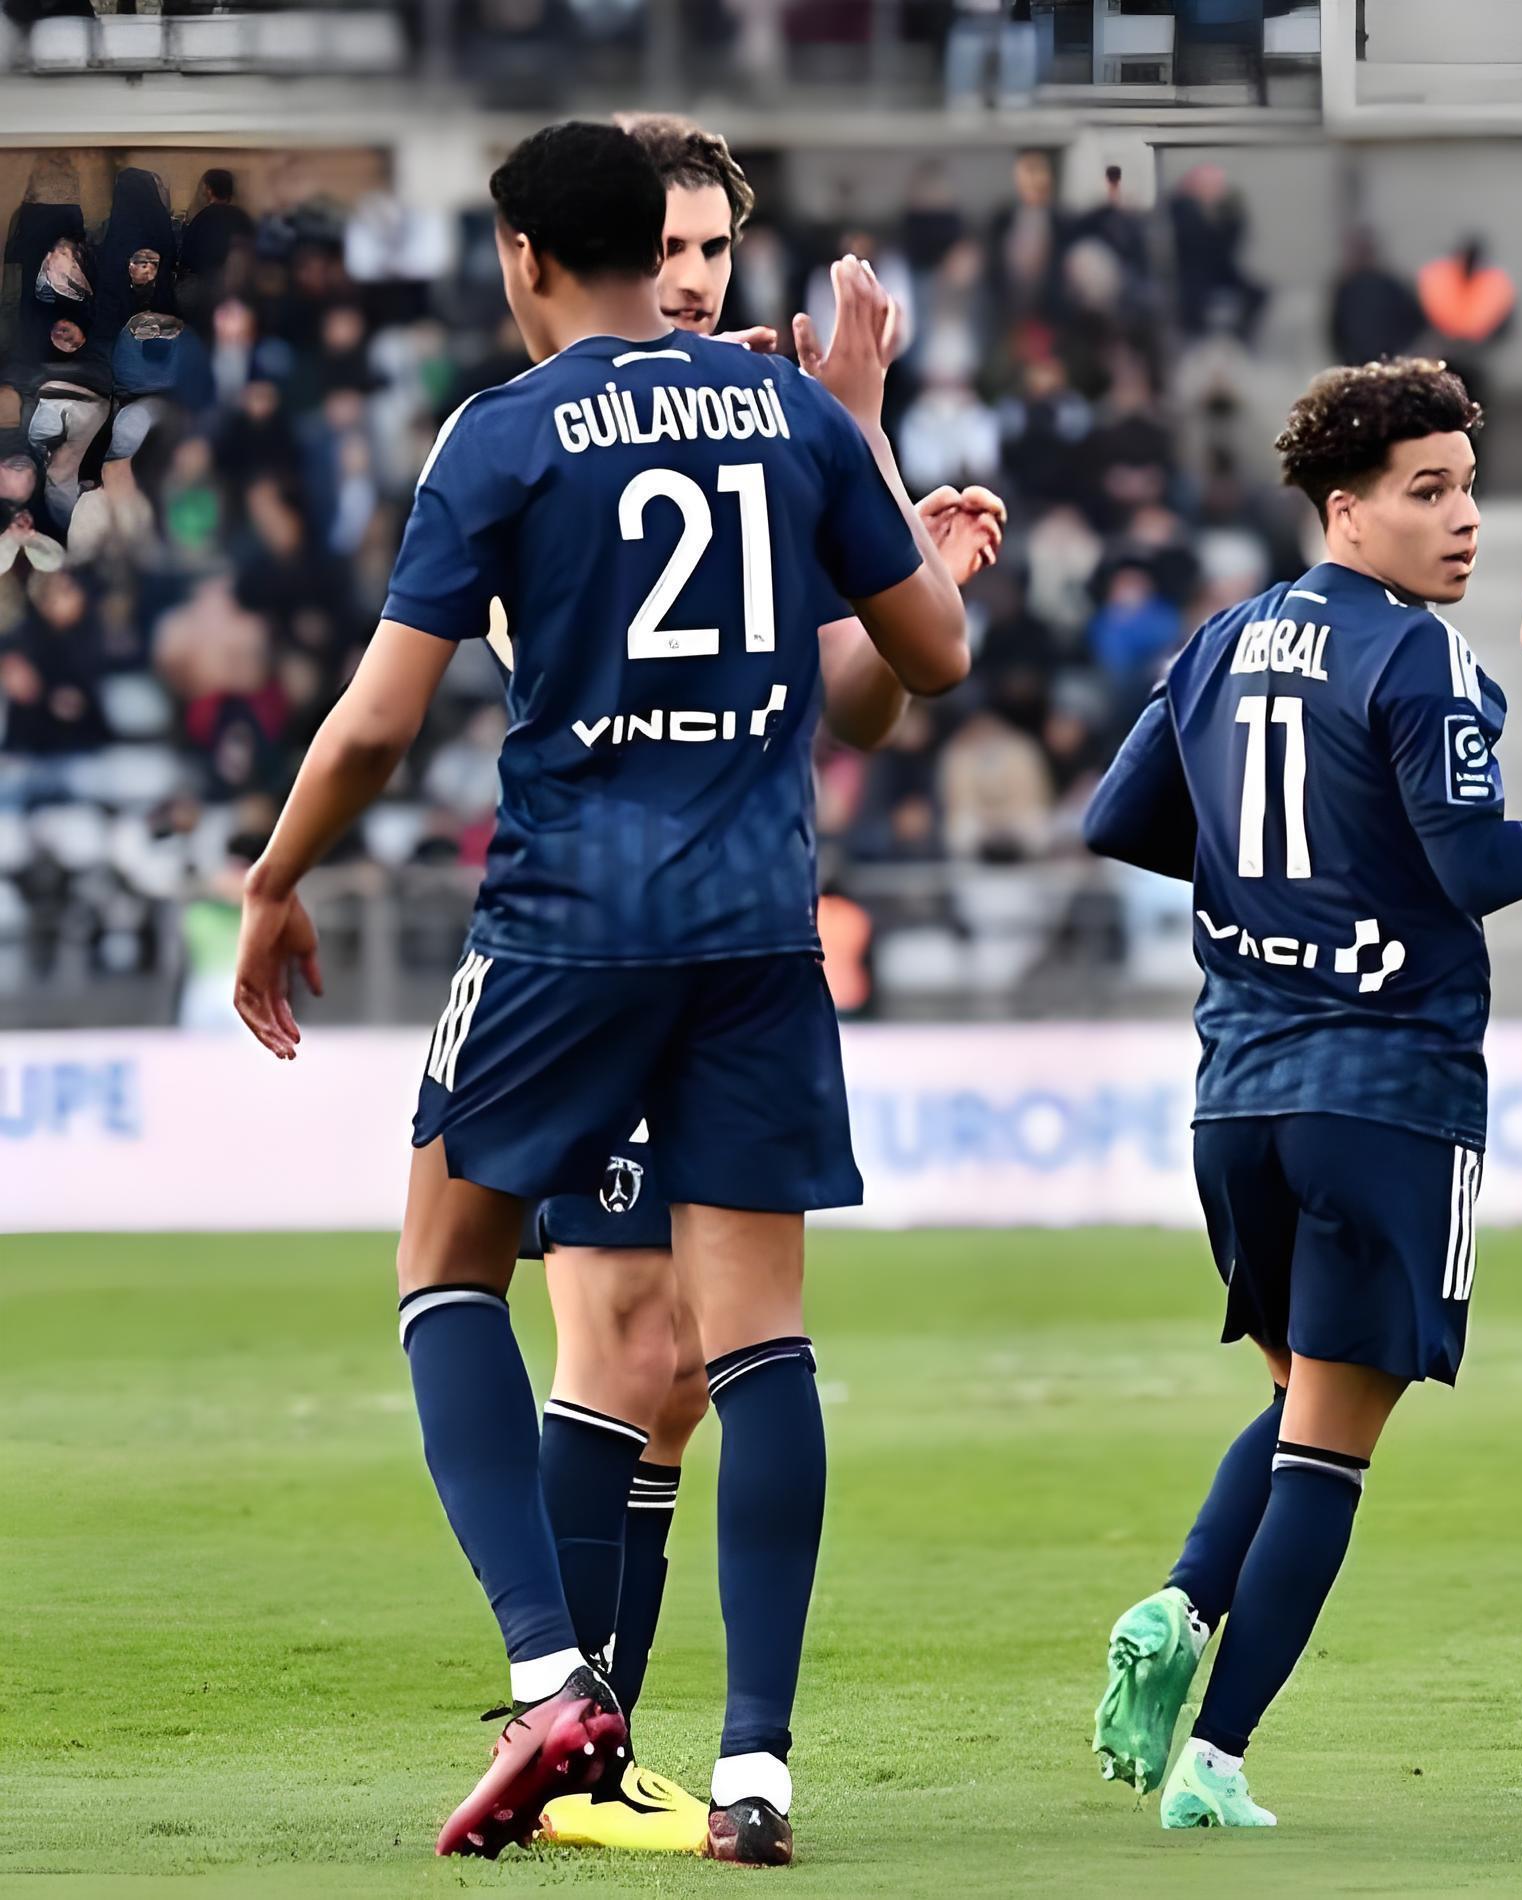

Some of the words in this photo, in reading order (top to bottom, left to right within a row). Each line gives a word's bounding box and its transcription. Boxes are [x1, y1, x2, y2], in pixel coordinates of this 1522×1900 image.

[617, 462, 776, 660] 21
[571, 709, 736, 748] VINCI
[1234, 695, 1312, 879] 11
